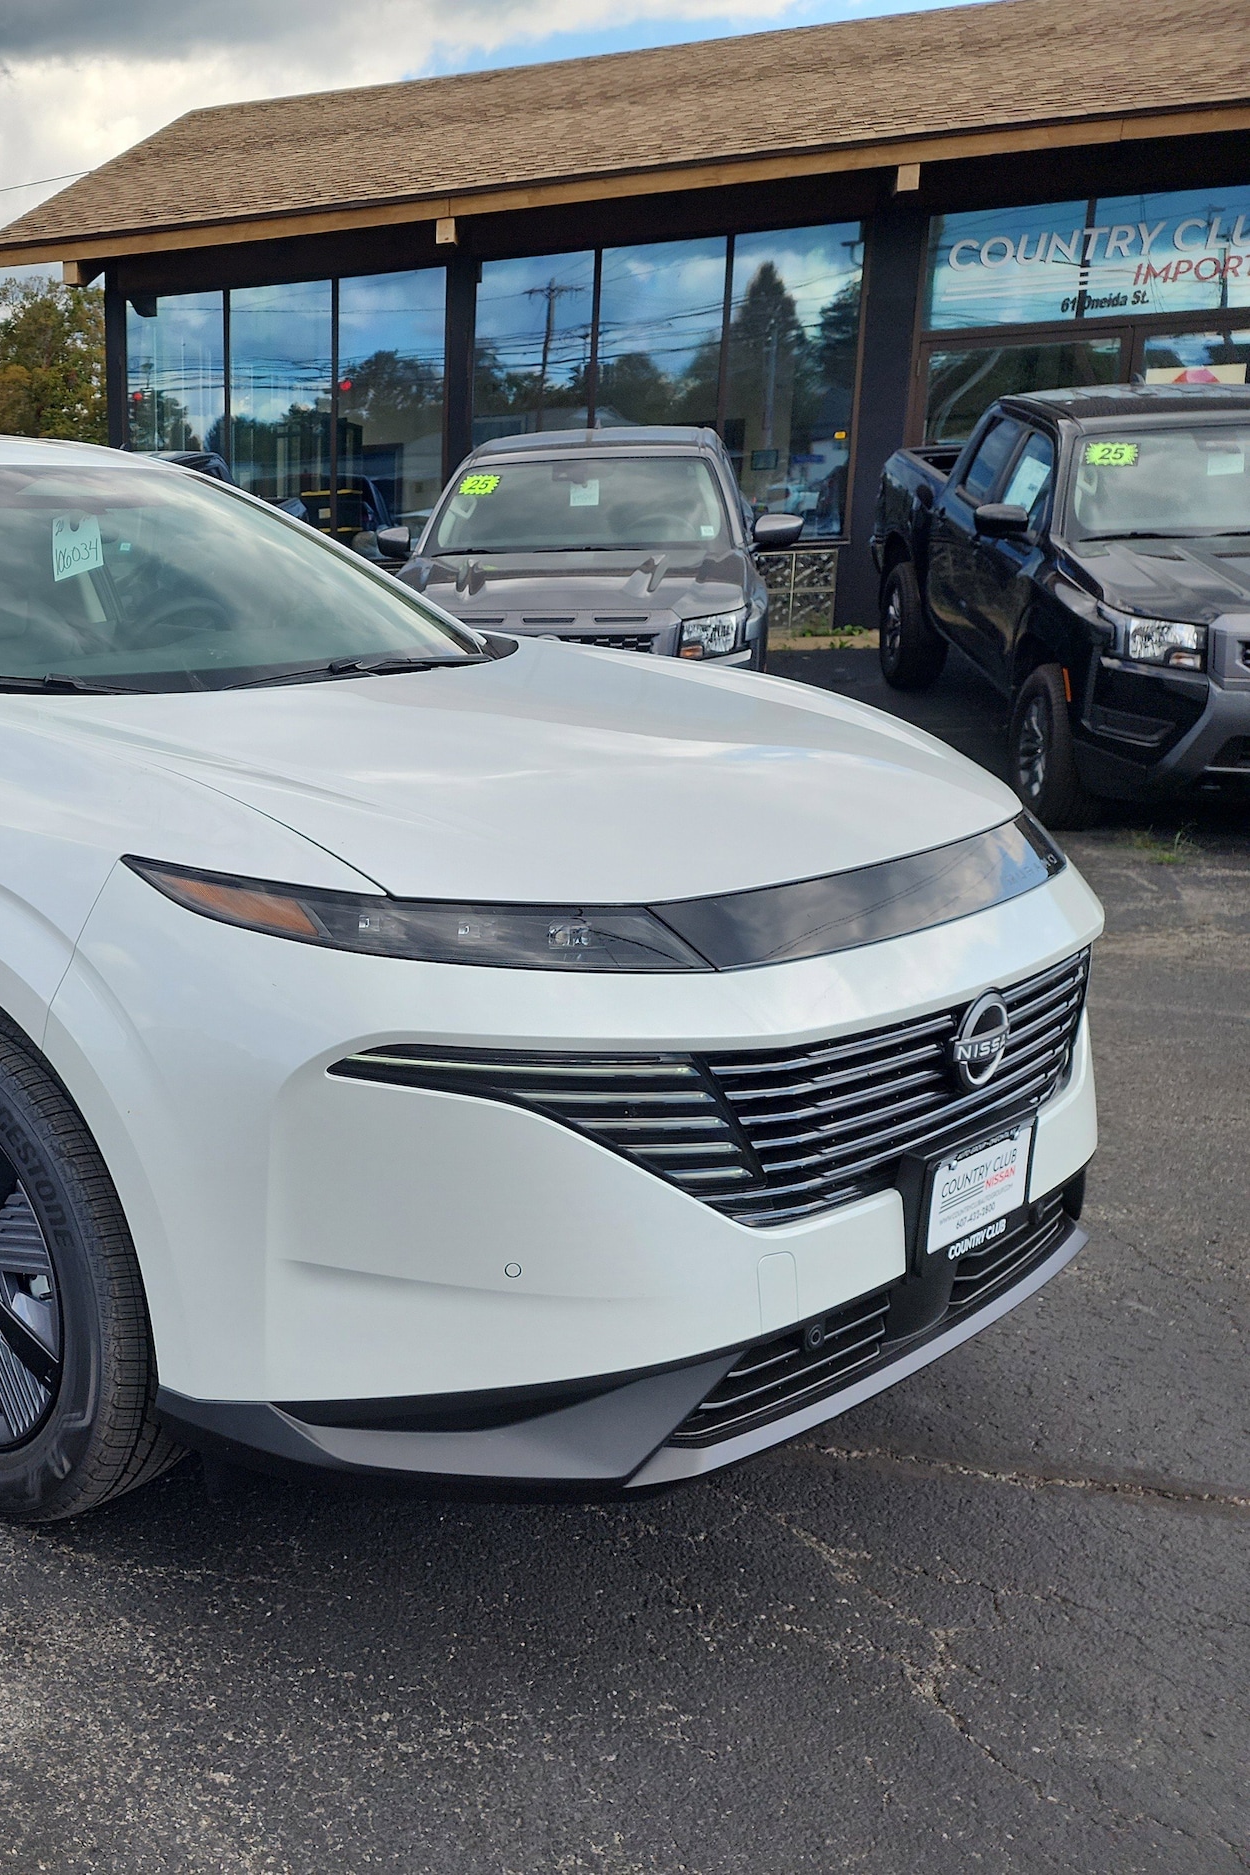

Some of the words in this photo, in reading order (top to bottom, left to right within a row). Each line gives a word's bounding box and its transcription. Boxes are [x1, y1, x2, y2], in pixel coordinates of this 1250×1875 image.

[949, 221, 1167, 271] COUNTRY
[1133, 254, 1250, 286] IMPOR
[1060, 296, 1077, 313] 61
[1084, 291, 1128, 310] Oneida
[1098, 447, 1125, 460] 25
[467, 479, 491, 491] 25
[957, 1034, 1006, 1060] NISSA
[941, 1160, 993, 1198] COUNTRY
[993, 1148, 1018, 1172] CLUB
[985, 1165, 1016, 1190] NISSAN
[948, 1228, 987, 1260] COUNTRY
[985, 1218, 1007, 1241] CLUB
